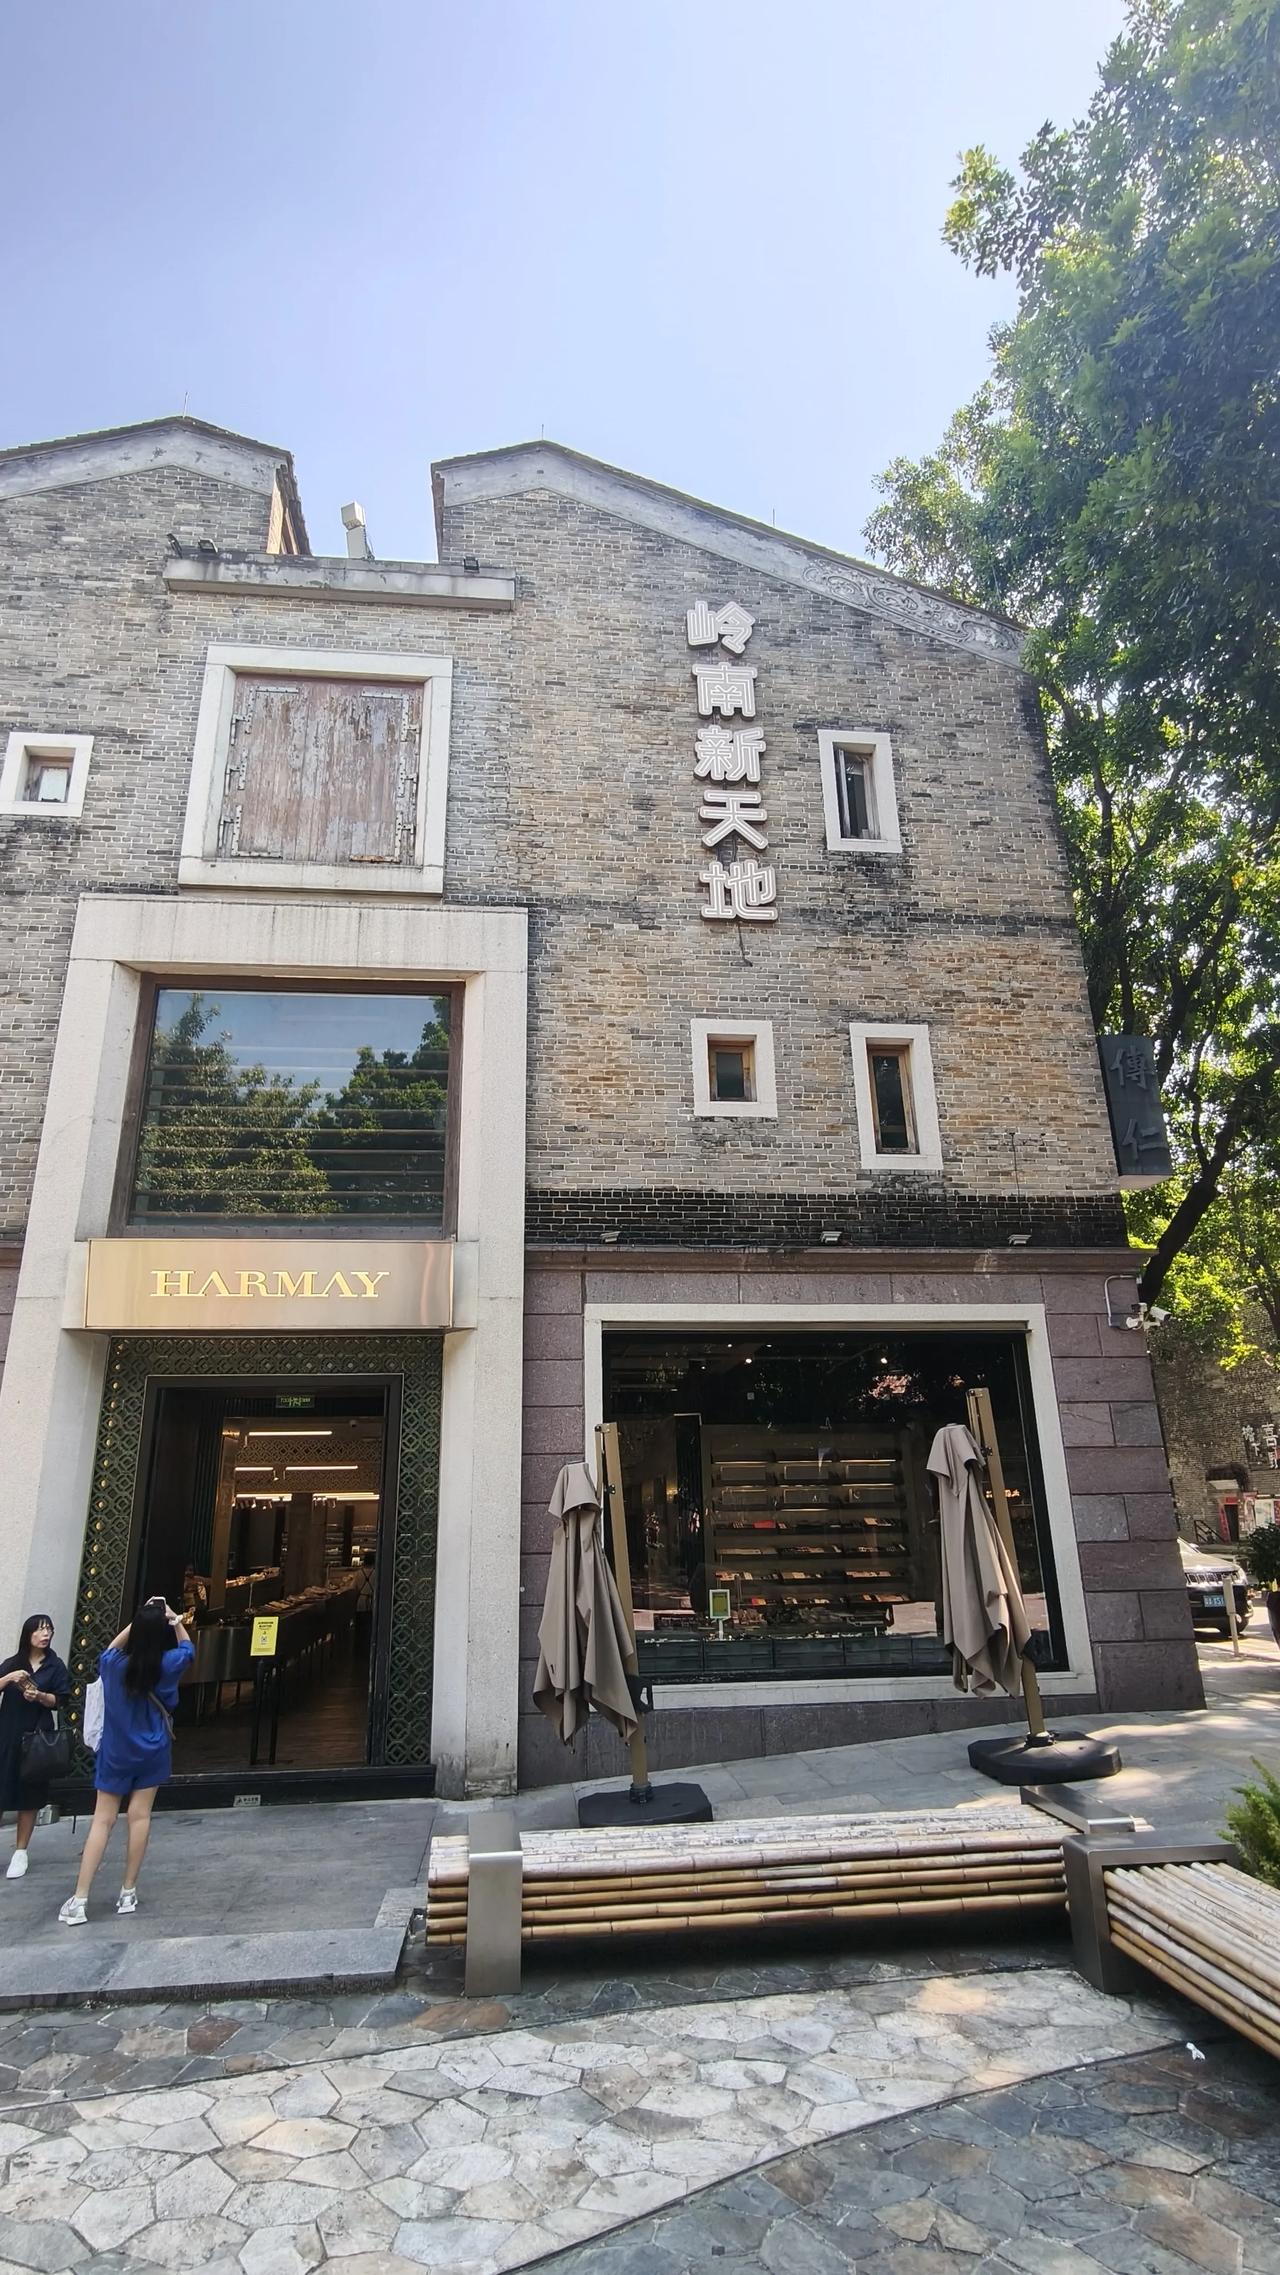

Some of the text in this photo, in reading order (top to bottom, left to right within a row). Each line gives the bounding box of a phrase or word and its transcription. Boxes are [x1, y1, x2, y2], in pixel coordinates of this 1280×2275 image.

[686, 600, 778, 922] 岭南新天地
[150, 1269, 390, 1298] HARMAY
